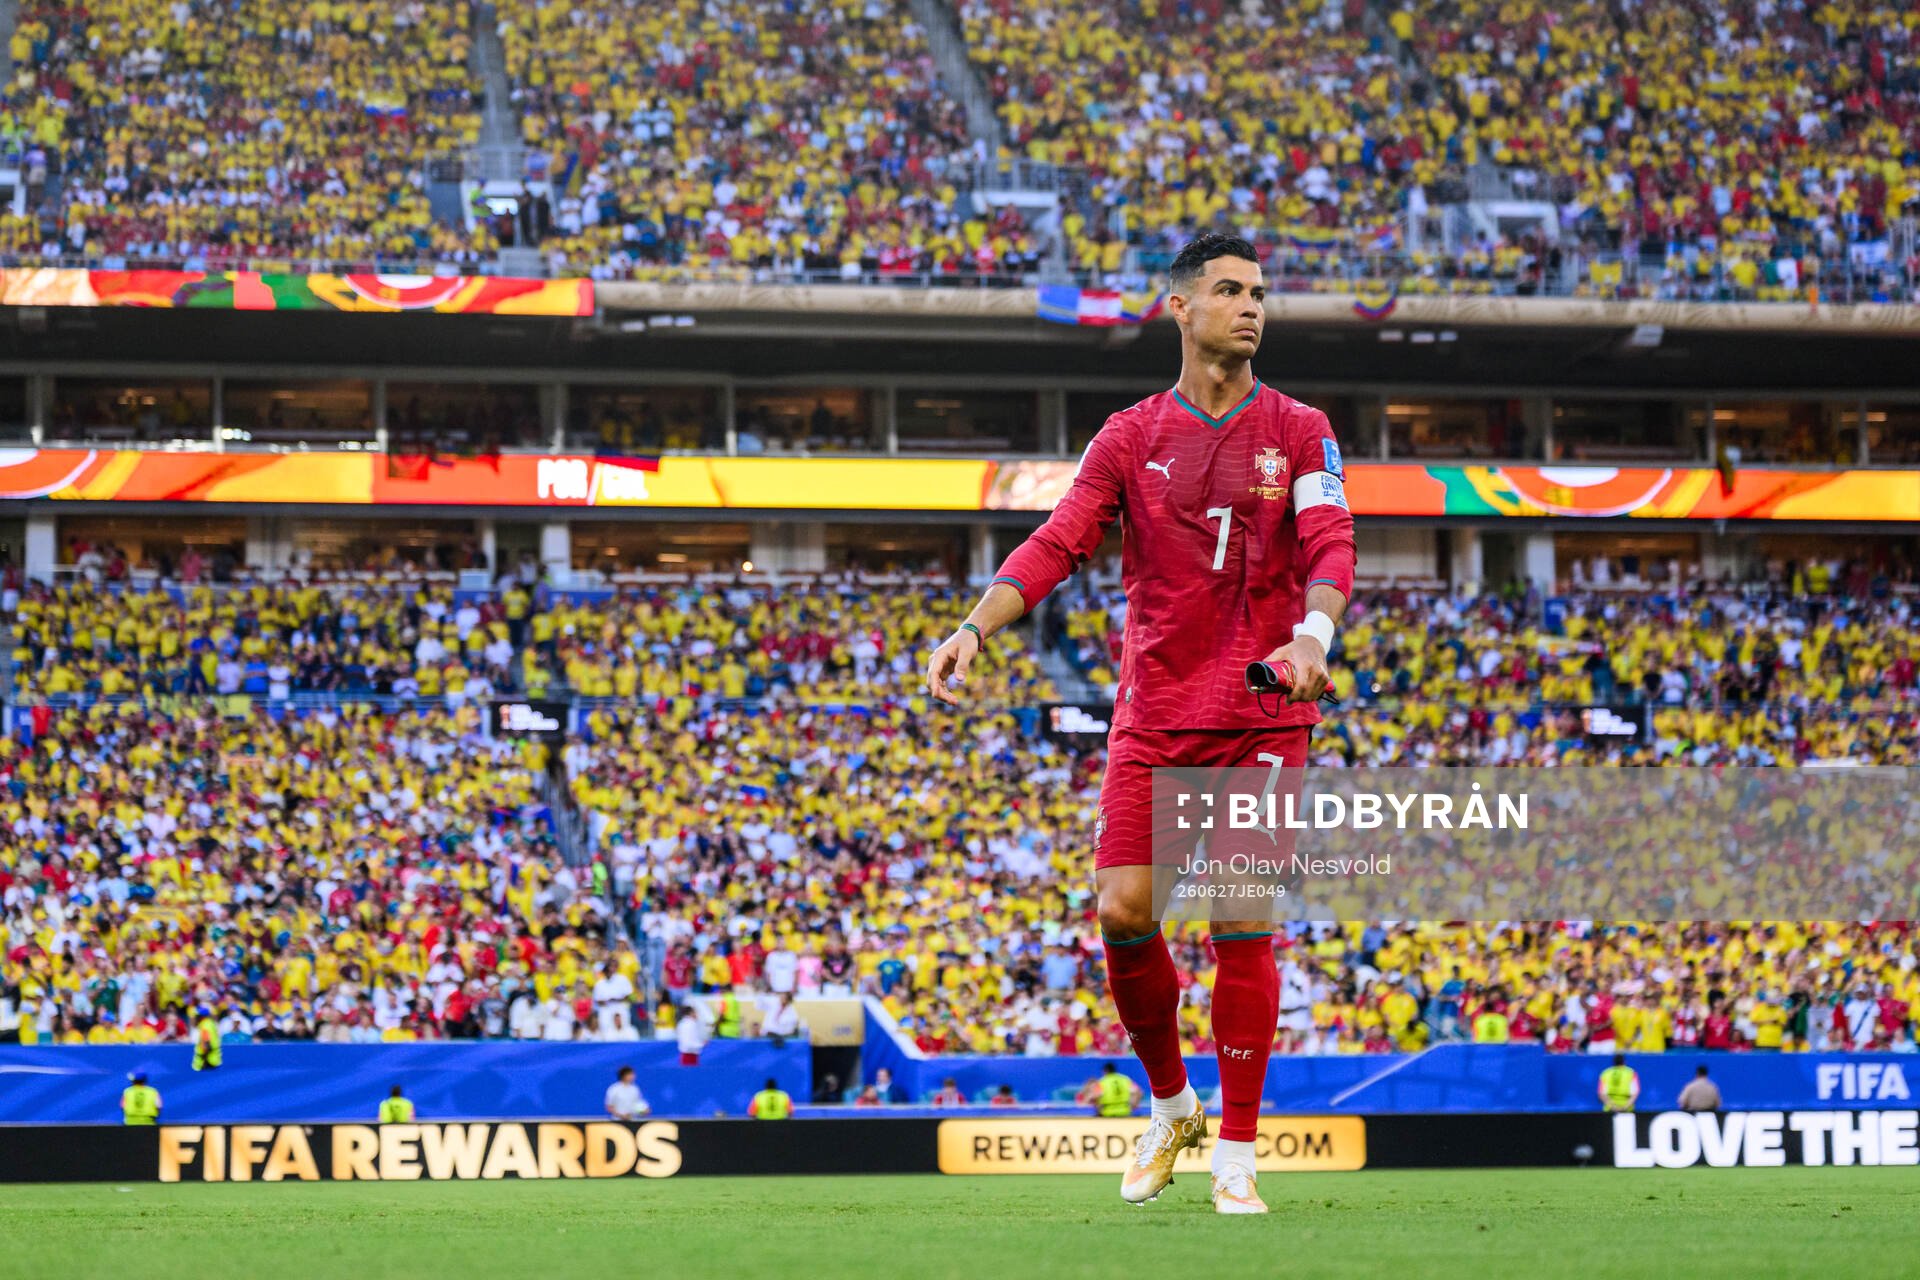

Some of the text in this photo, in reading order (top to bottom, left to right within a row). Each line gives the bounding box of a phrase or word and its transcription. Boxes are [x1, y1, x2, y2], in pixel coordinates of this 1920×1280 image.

[1206, 506, 1233, 570] 7
[1257, 752, 1284, 816] 7
[1817, 1063, 1910, 1100] FIFA
[159, 1122, 682, 1182] FIFA REWARDS
[1182, 1110, 1204, 1137] CR7
[1613, 1110, 1920, 1169] LOVE THE
